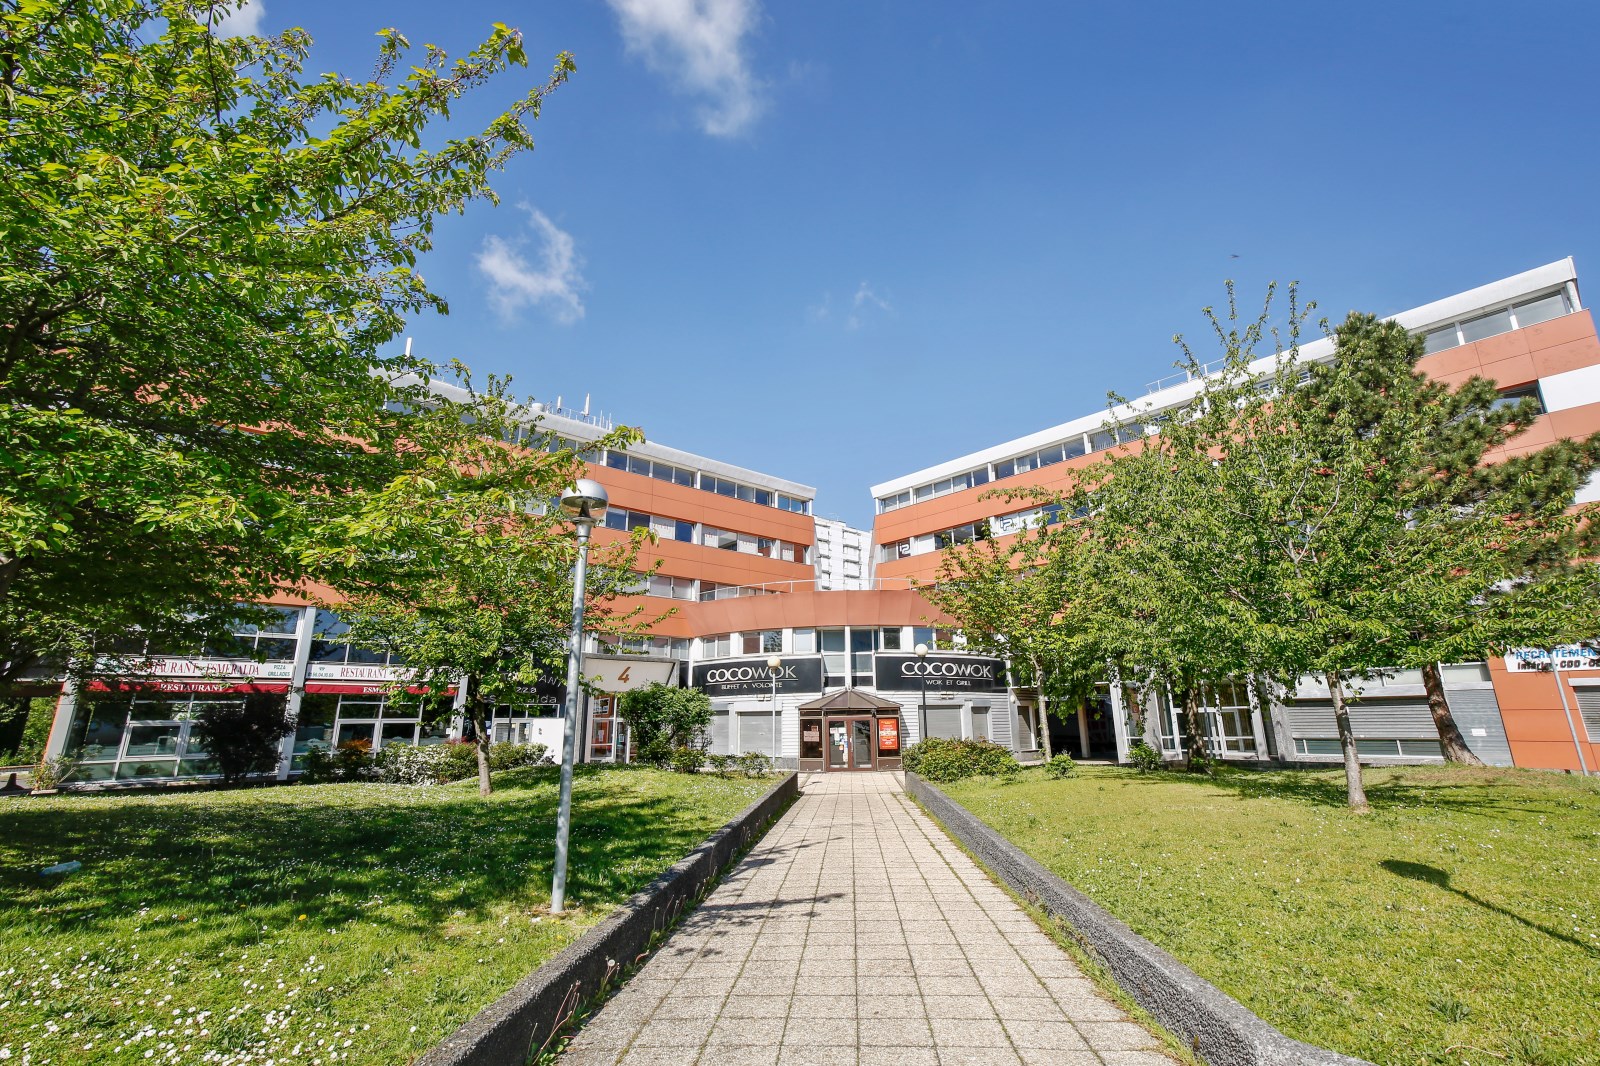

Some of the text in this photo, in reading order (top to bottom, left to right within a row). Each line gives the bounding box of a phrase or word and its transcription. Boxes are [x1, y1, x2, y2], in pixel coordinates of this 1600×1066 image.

[206, 662, 260, 676] ESMERALDA
[901, 661, 992, 678] COCOWOK
[1560, 660, 1581, 669] CDD
[340, 667, 387, 679] RESTAURANT
[618, 666, 631, 683] 4
[707, 665, 797, 683] COCOWOK
[160, 683, 224, 693] RESTAURANT
